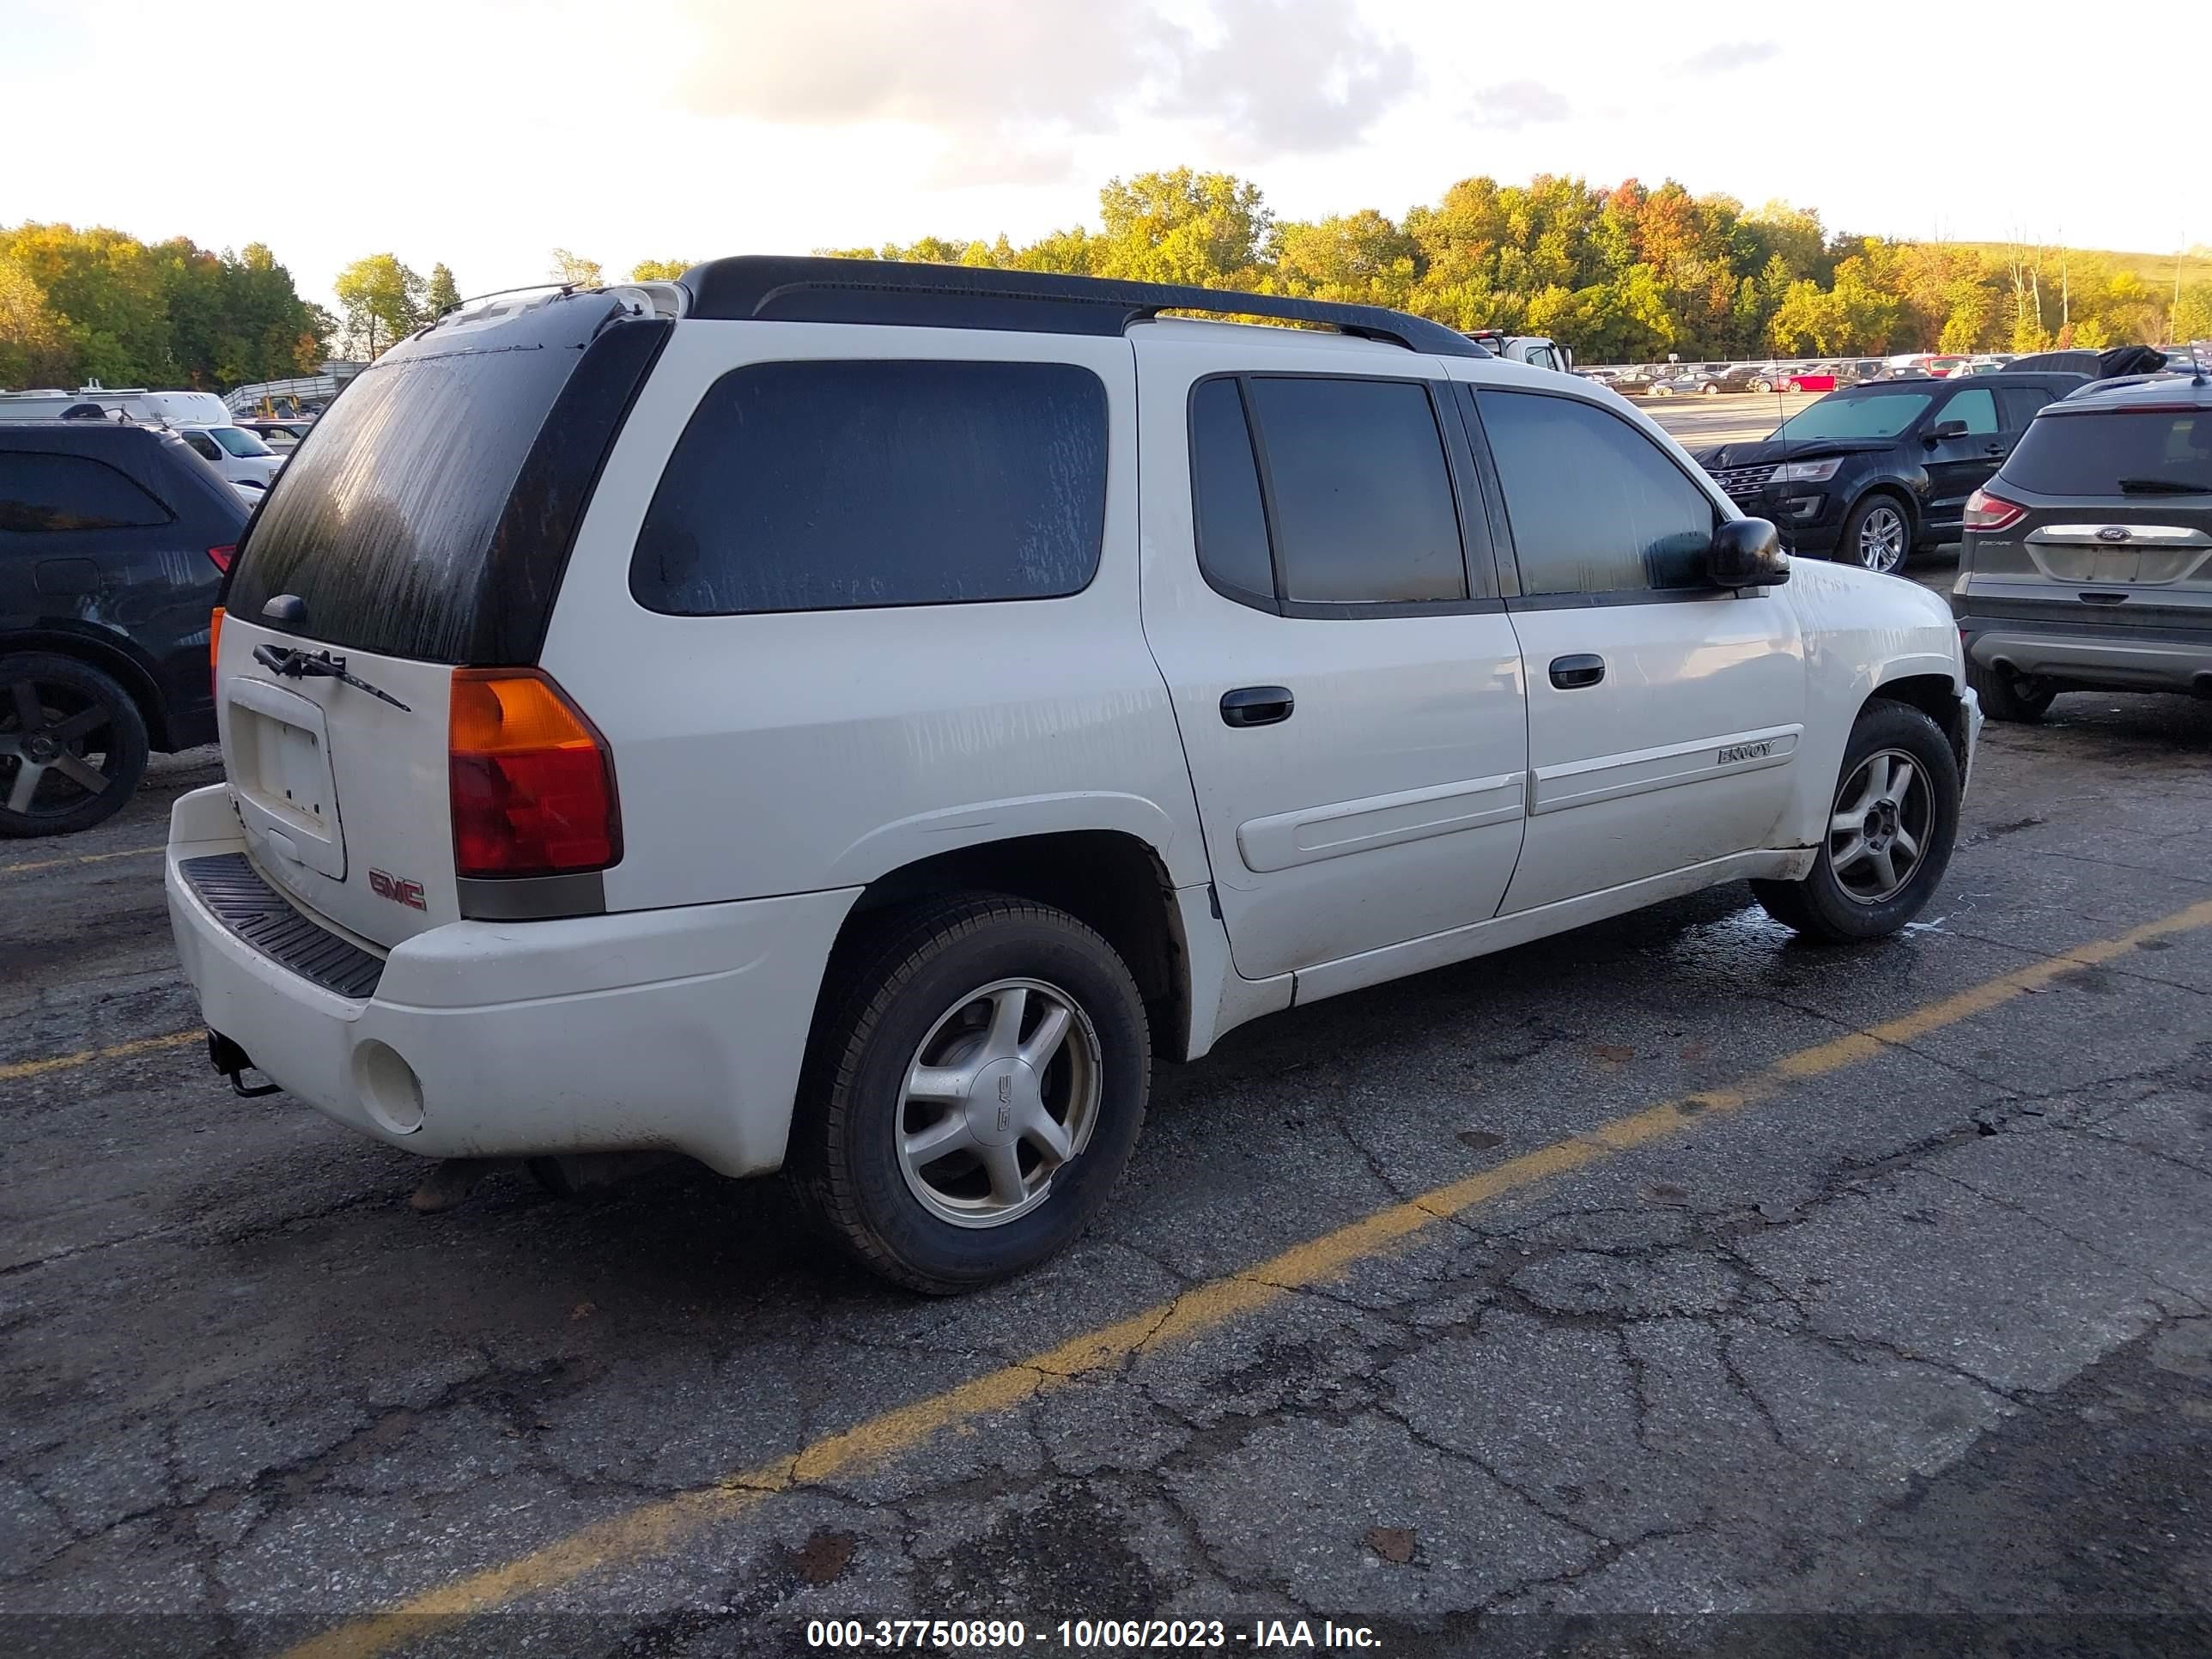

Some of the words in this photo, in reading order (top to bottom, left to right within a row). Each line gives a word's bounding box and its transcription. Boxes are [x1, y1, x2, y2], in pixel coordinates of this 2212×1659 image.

[1717, 740, 1778, 764] ENVOY
[368, 866, 428, 912] GMC
[997, 1075, 1012, 1132] GMC
